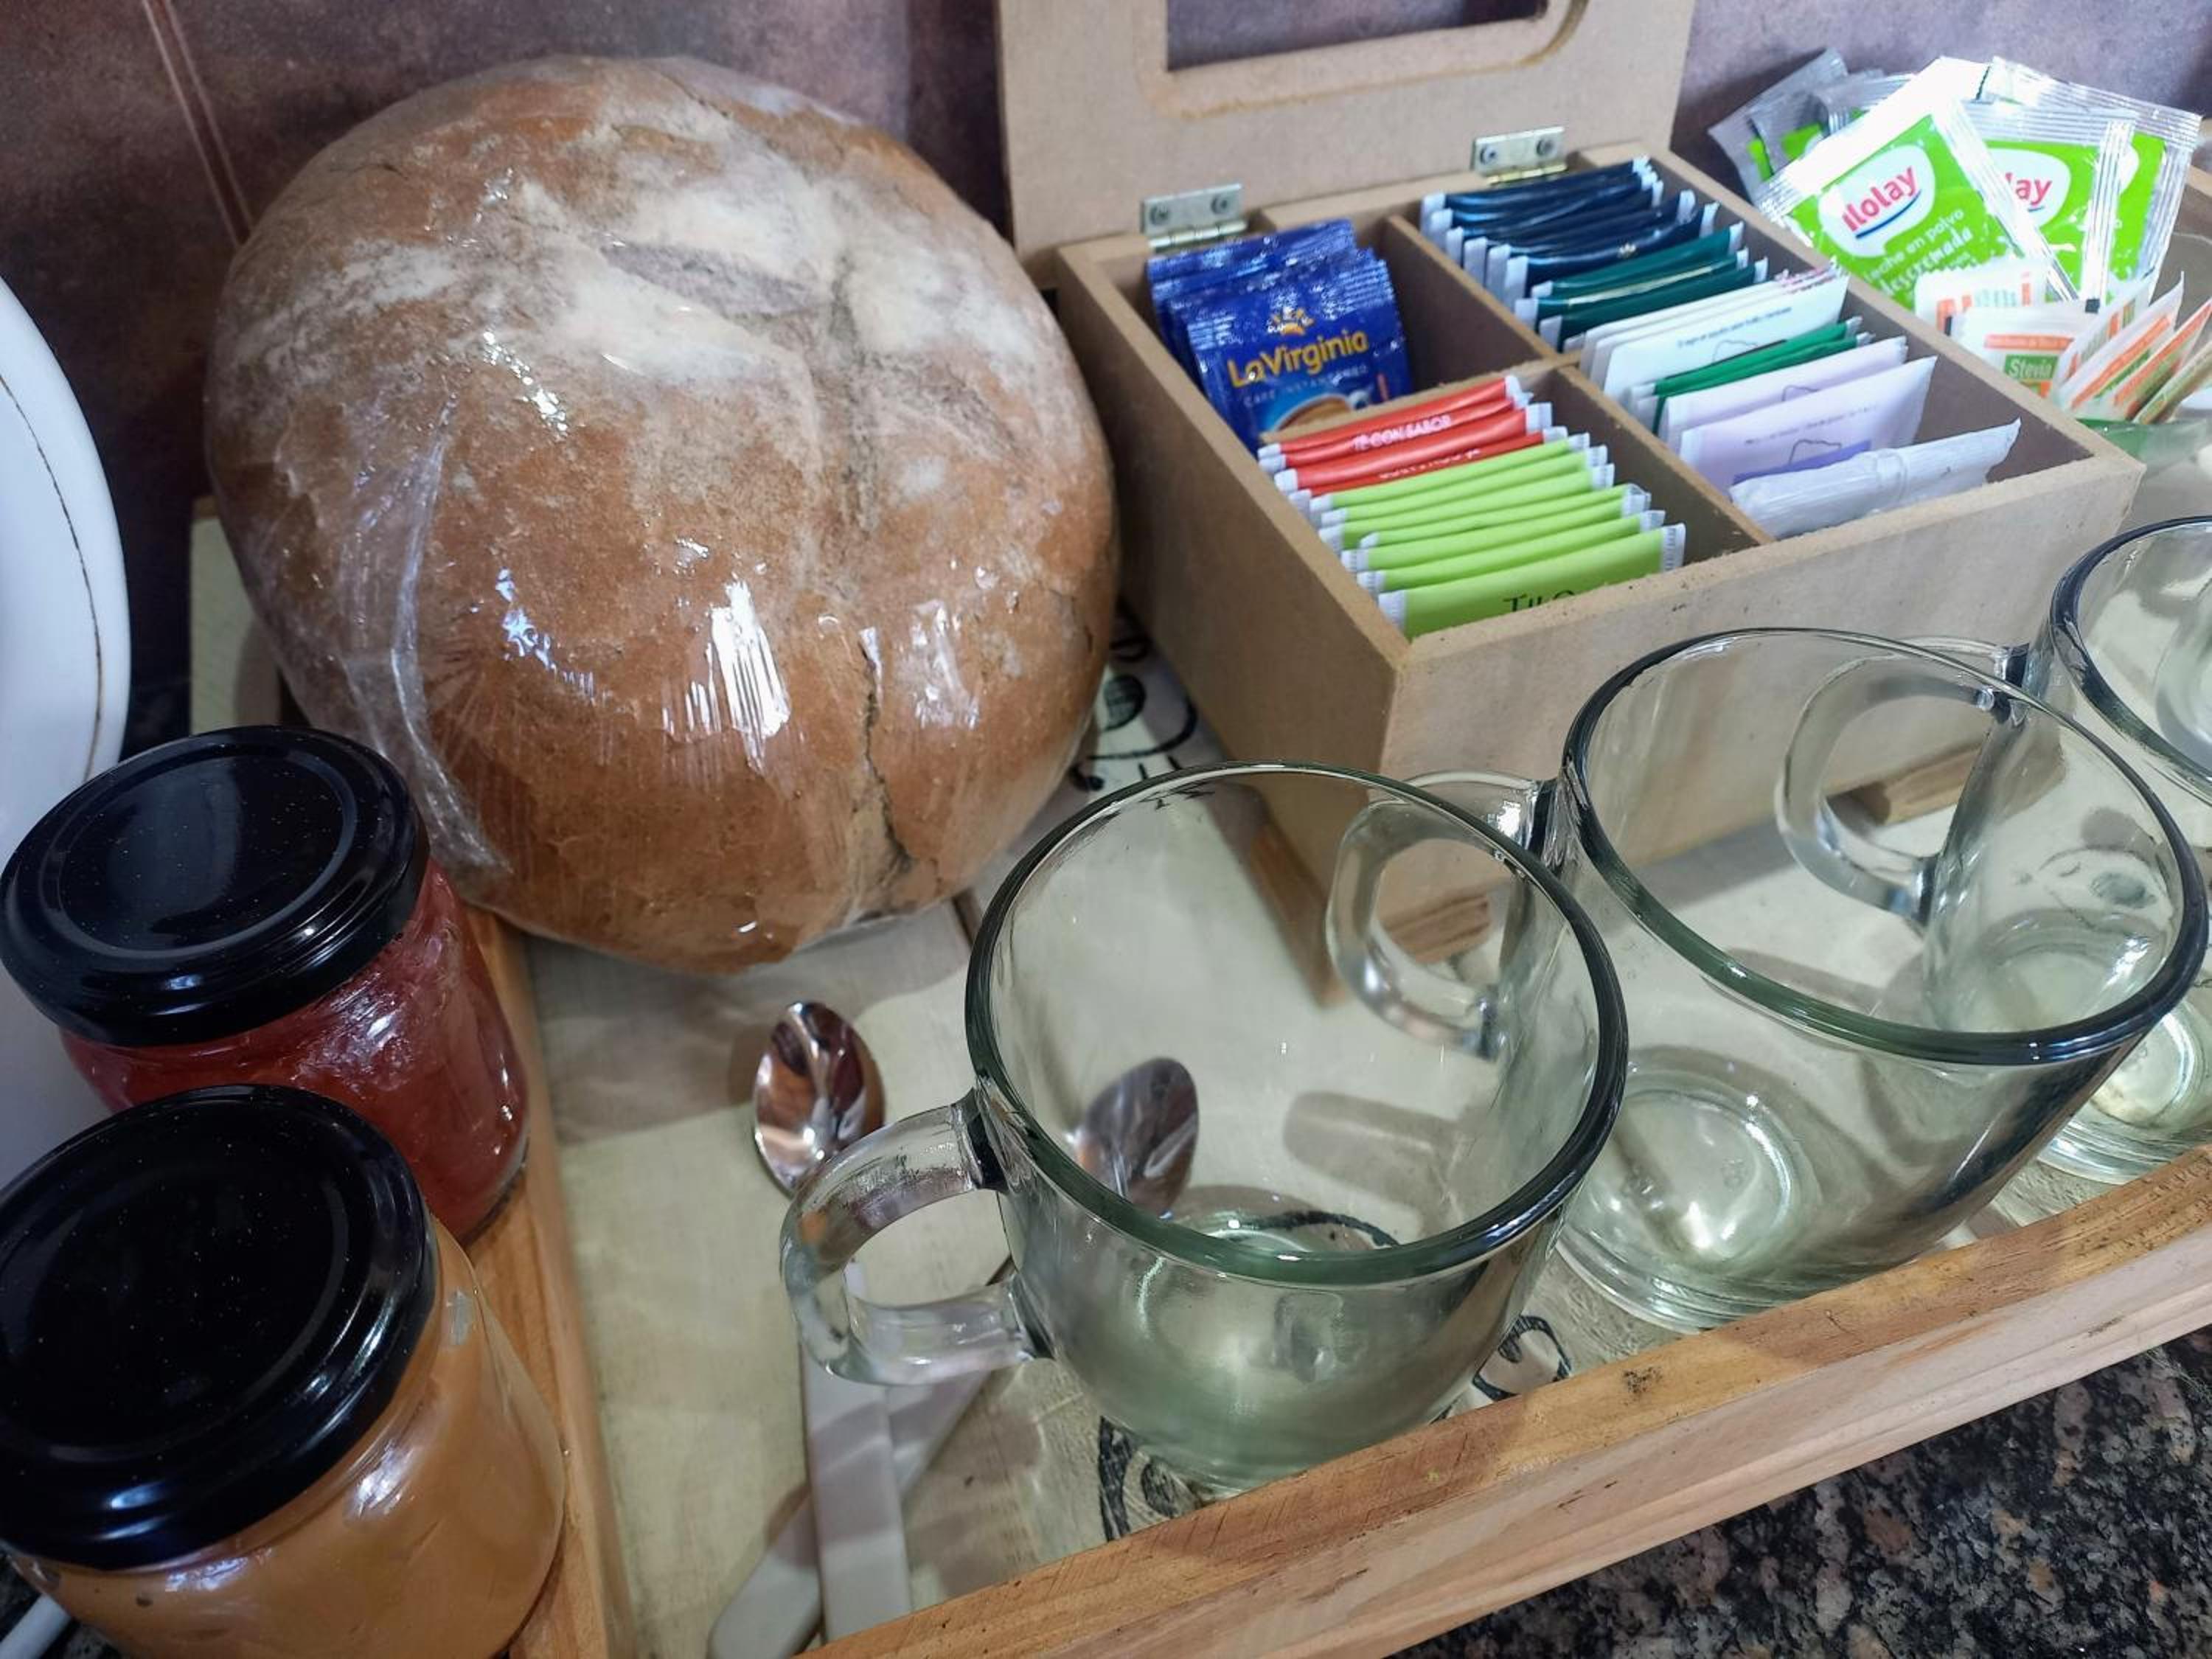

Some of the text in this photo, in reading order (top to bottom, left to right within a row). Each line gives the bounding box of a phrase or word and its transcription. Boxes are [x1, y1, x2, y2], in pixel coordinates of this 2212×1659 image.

[1907, 234, 1927, 254] en
[2010, 357, 2053, 381] Stevia
[1405, 414, 1452, 438] SABOR
